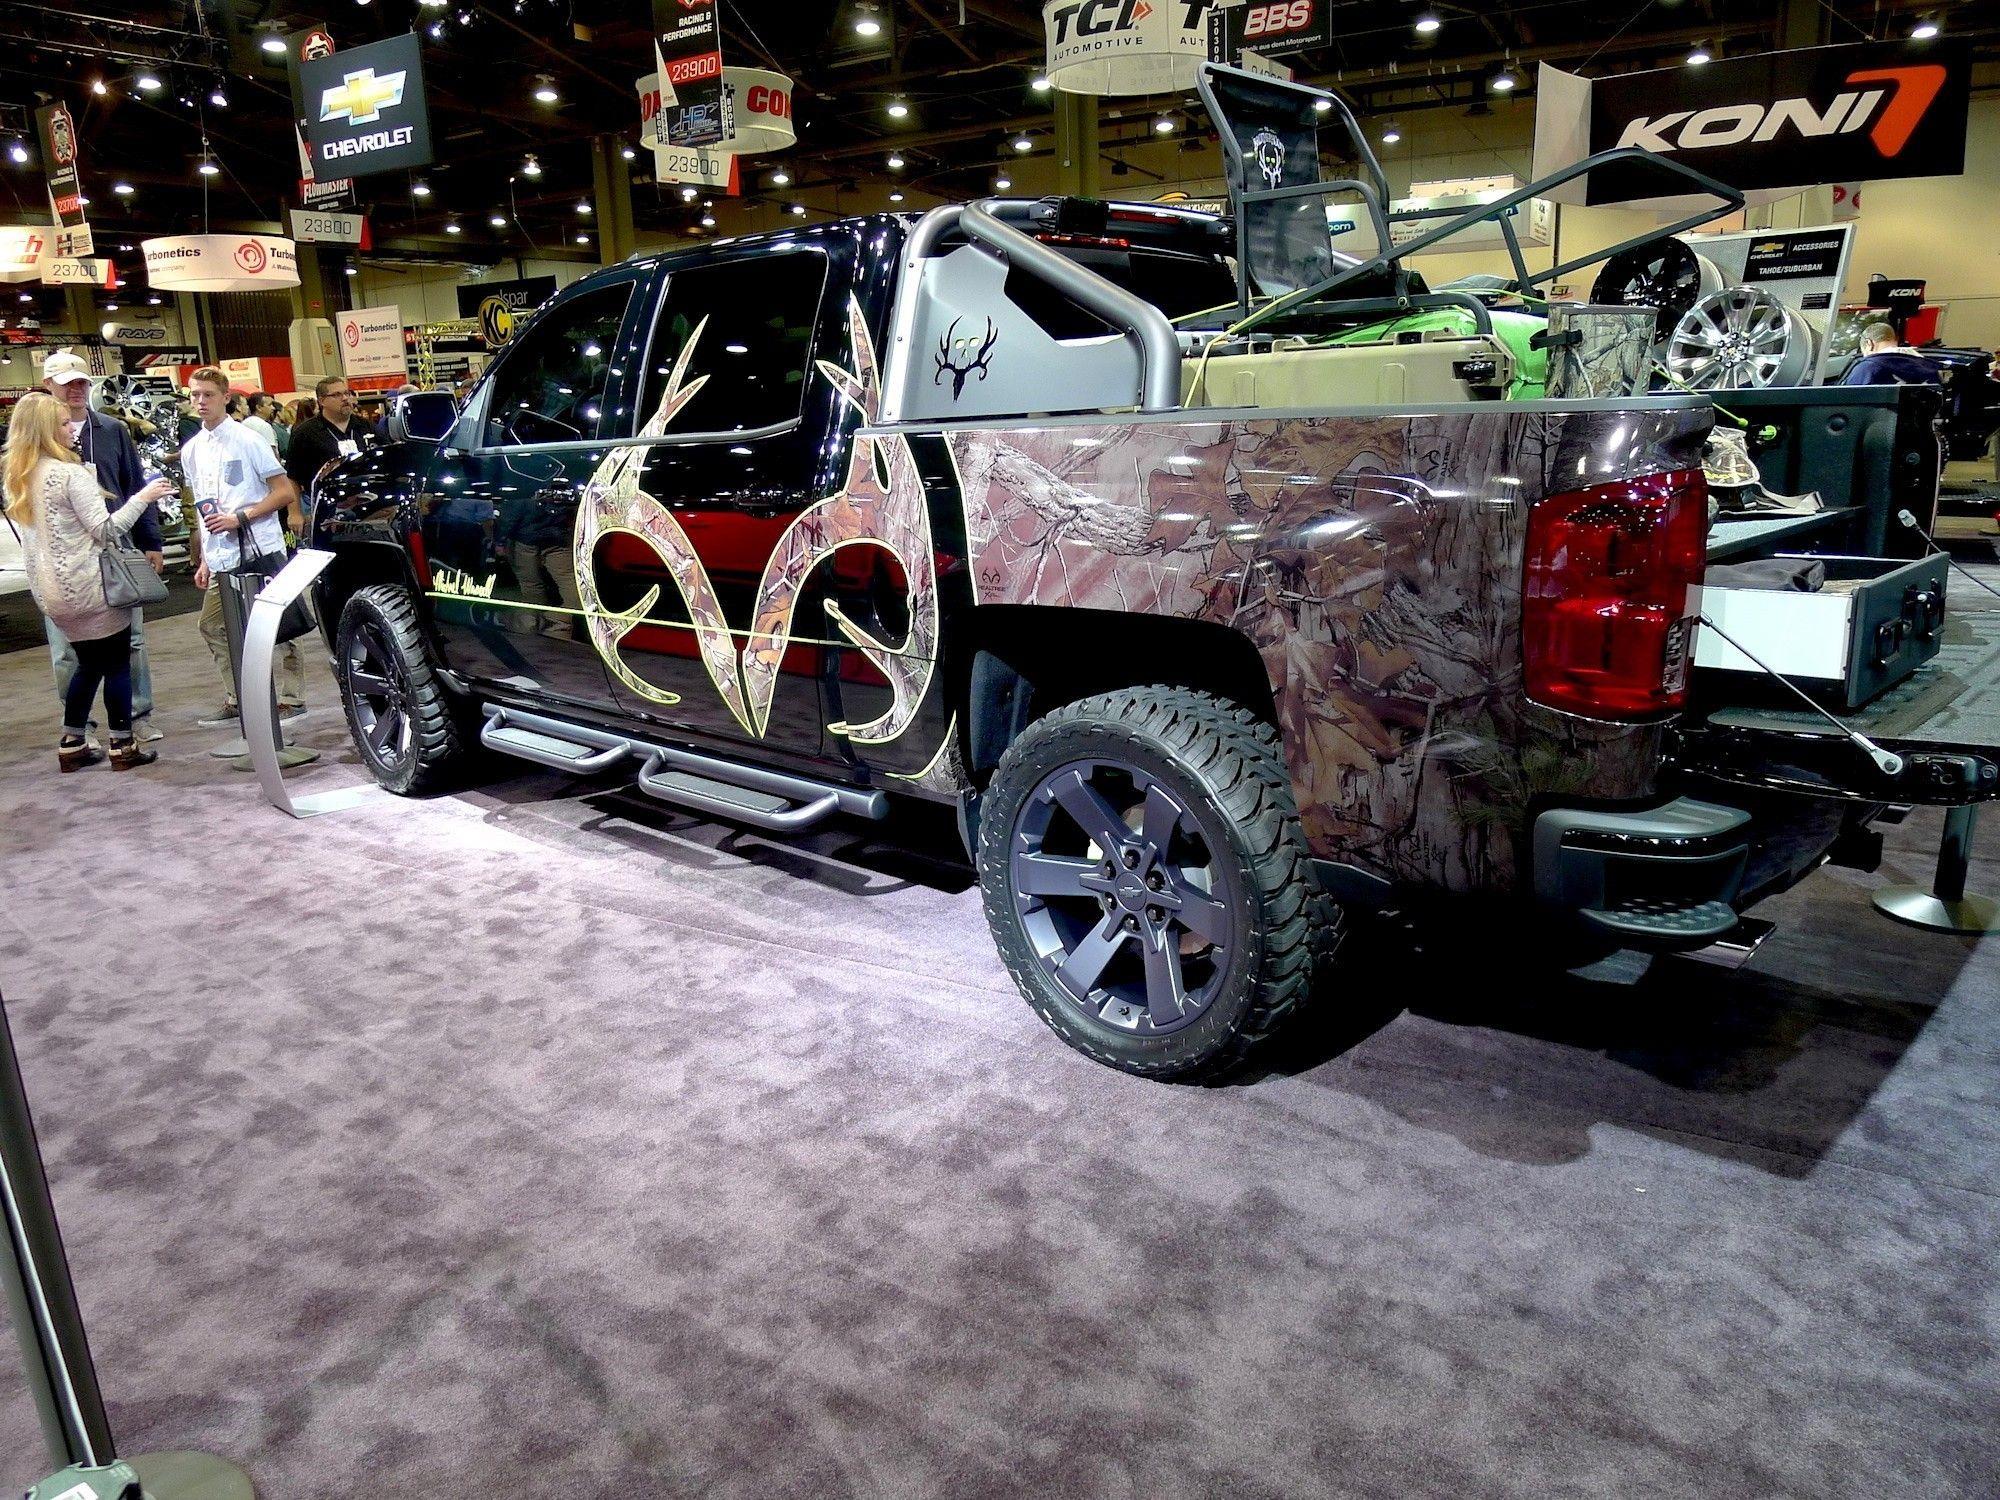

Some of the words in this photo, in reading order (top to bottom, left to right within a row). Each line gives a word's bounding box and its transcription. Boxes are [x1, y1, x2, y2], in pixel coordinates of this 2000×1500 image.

[678, 13, 705, 27] RACING
[706, 11, 712, 21] &
[1244, 0, 1311, 36] BBS
[662, 22, 713, 43] PERFORMANCE
[1271, 40, 1286, 48] dem
[1286, 34, 1322, 46] Motorsport
[1054, 36, 1144, 61] AUTOMOTIVE
[1180, 36, 1206, 47] AUT
[671, 56, 717, 82] 23900
[725, 97, 735, 135] BOOTH
[1615, 89, 1885, 154] KONI
[323, 126, 414, 161] CHEVROLET
[668, 155, 720, 177] 23900
[304, 218, 352, 235] 23800
[1792, 240, 1840, 252] ACCESSORIES
[52, 264, 98, 277] 23700
[1759, 262, 1824, 275] TAHOE/SUBURBAN
[499, 288, 529, 306] lspar
[360, 322, 398, 334] Turbonetics
[483, 302, 509, 344] KC
[117, 328, 165, 339] RAYS
[152, 353, 198, 366] ACT
